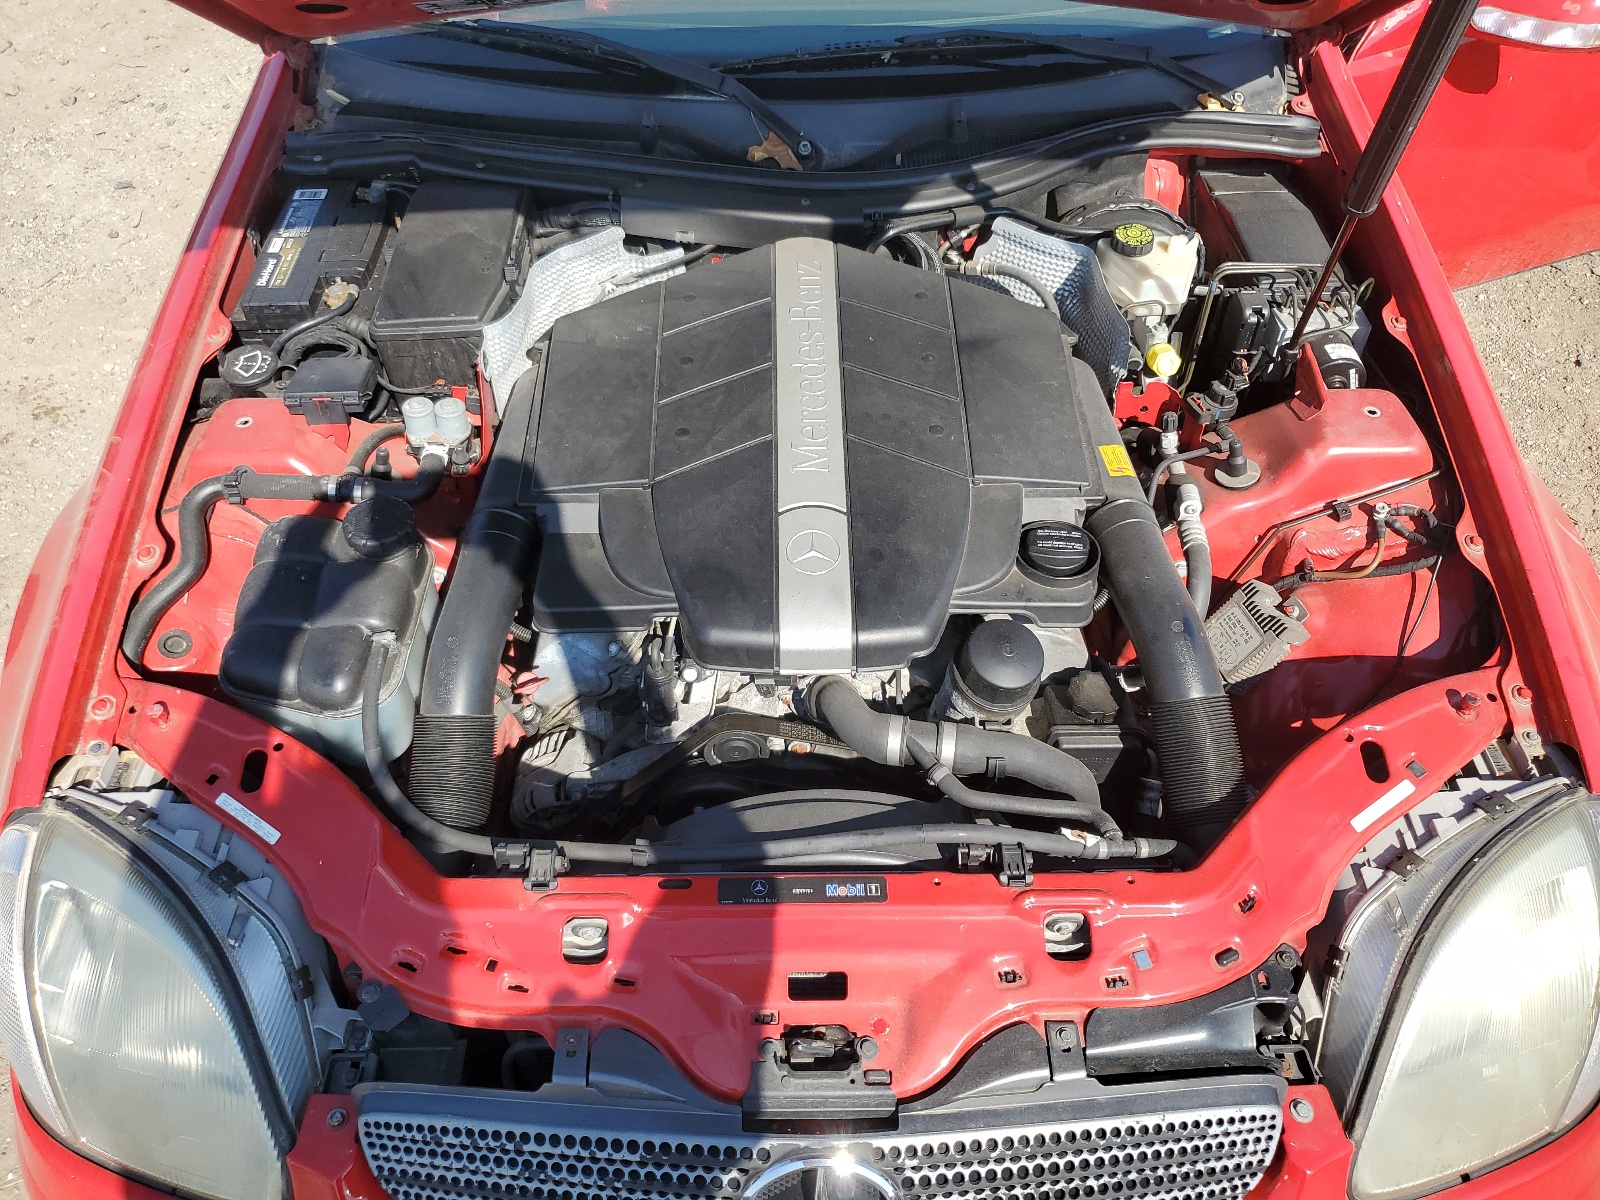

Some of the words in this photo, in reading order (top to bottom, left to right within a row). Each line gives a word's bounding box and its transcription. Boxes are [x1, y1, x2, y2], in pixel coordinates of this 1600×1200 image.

[256, 259, 278, 286] DieHard
[788, 261, 831, 475] Mercedes-Benz
[826, 884, 865, 897] Mobil
